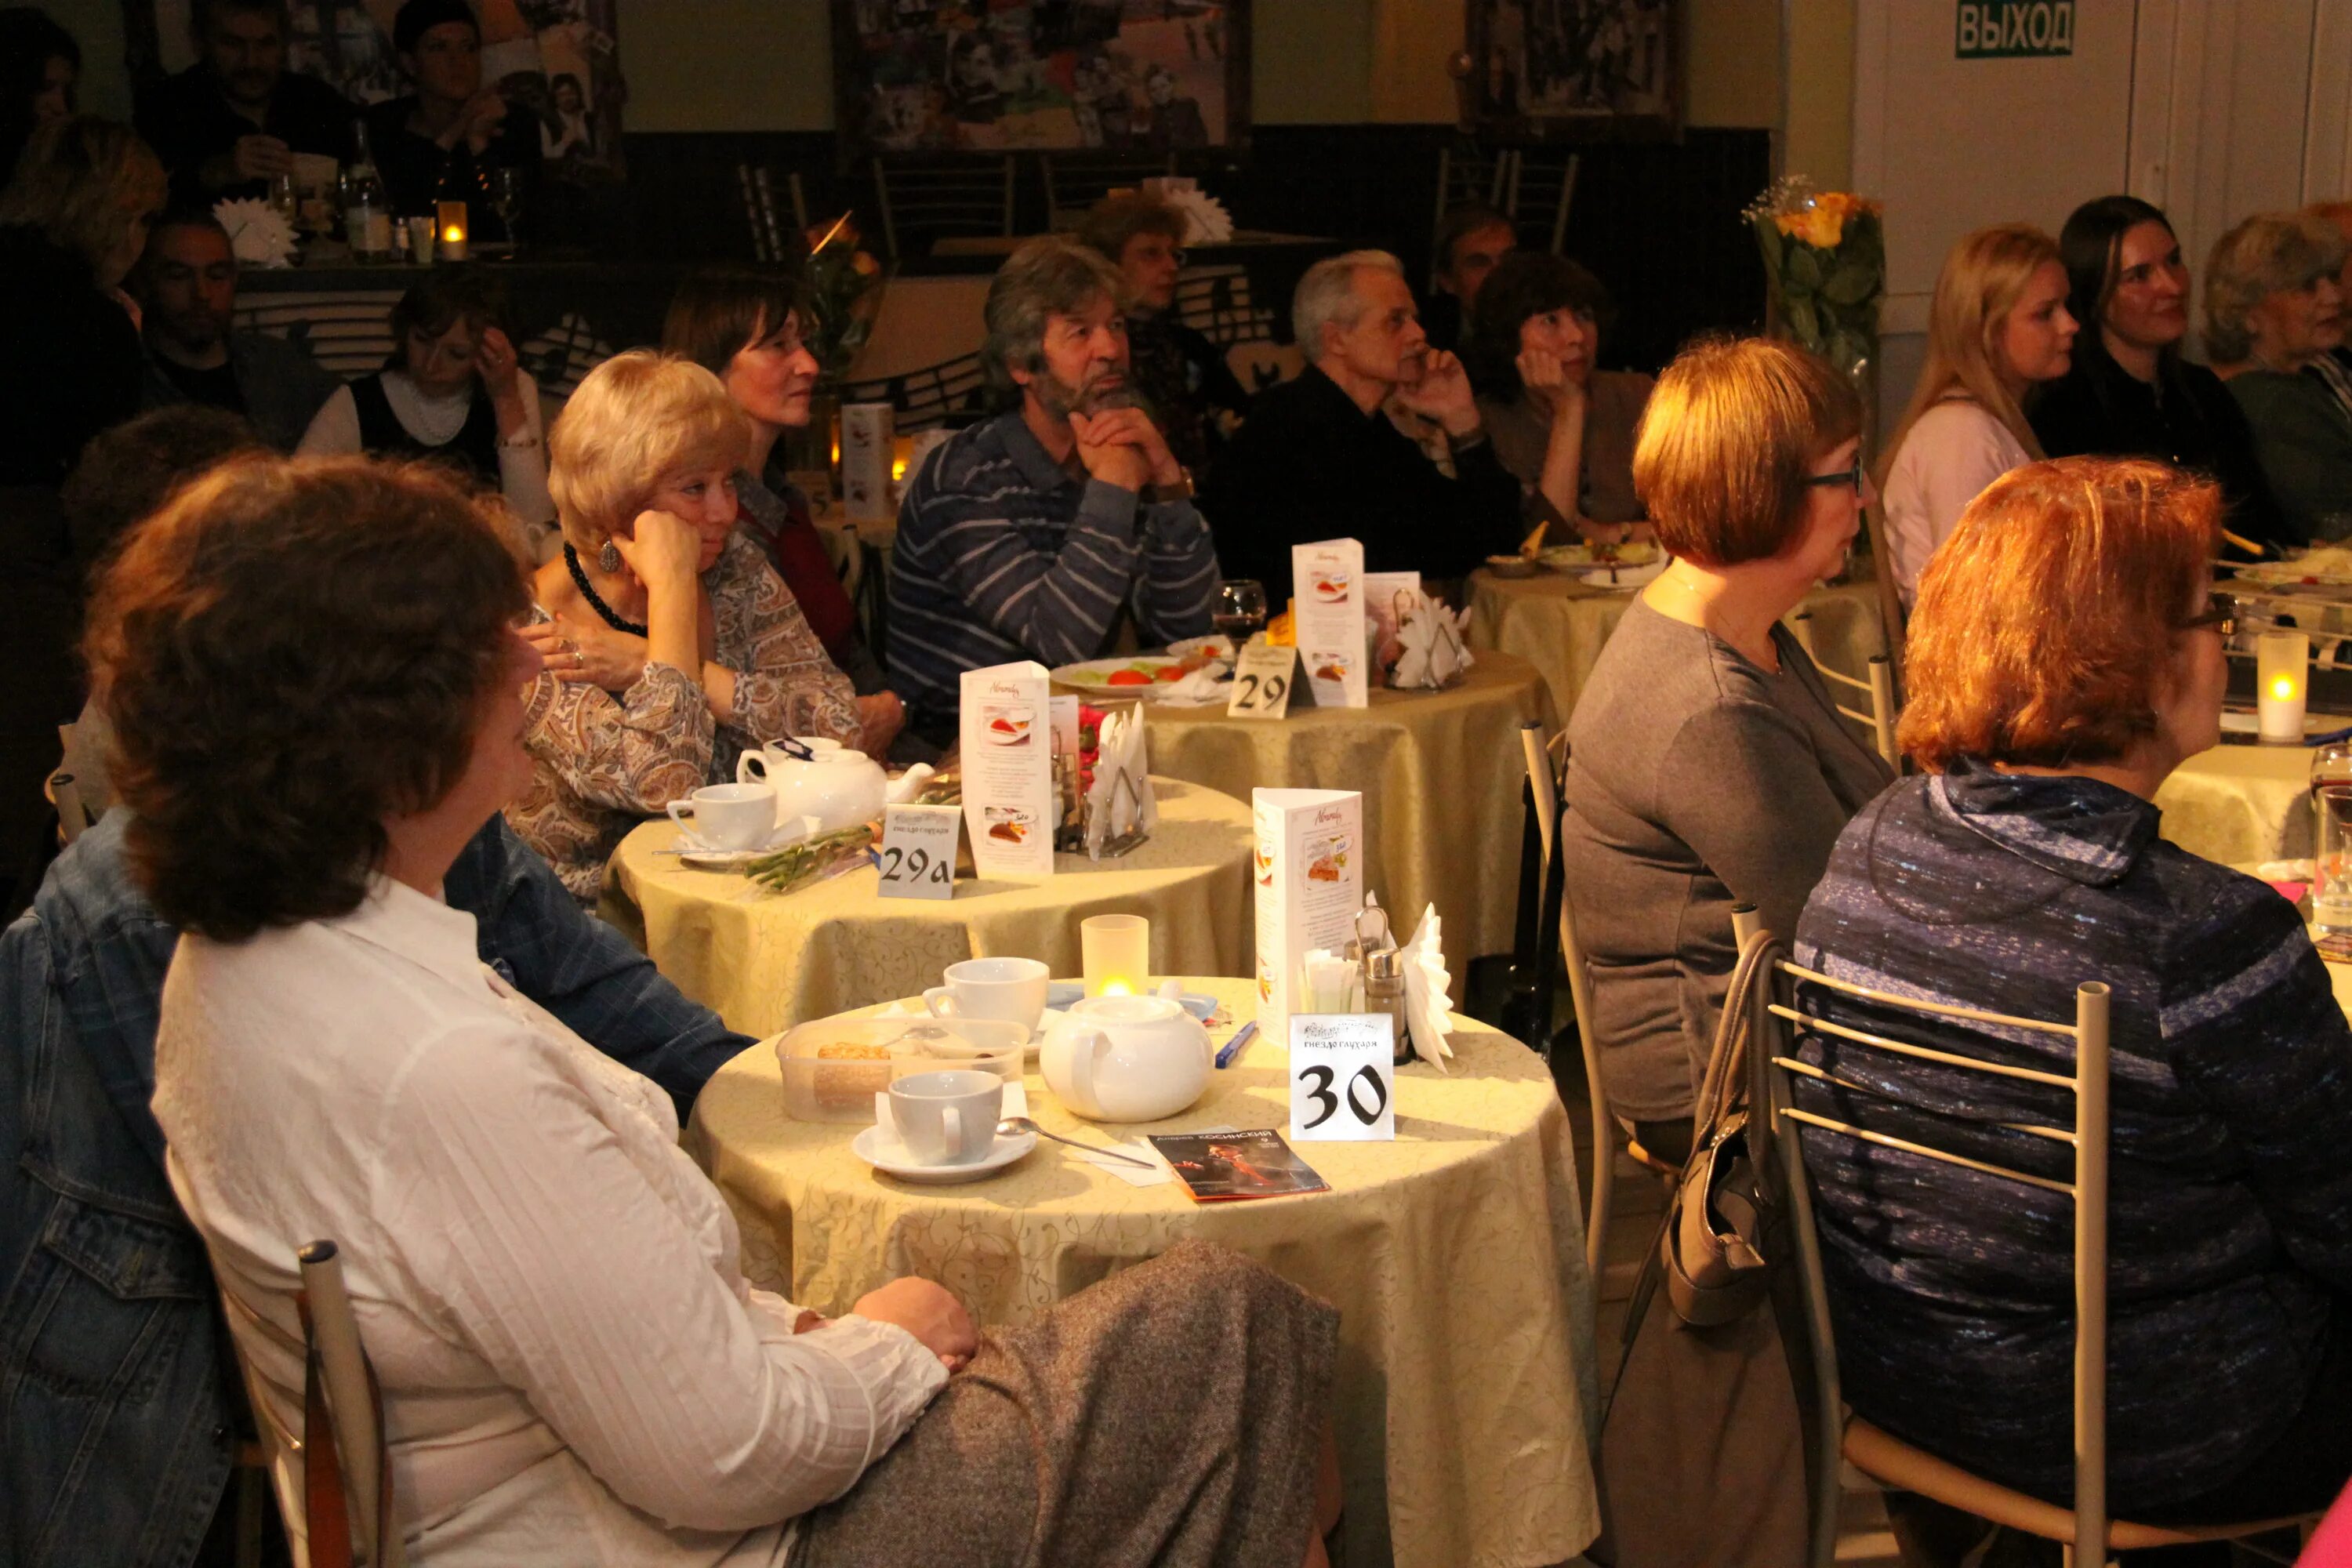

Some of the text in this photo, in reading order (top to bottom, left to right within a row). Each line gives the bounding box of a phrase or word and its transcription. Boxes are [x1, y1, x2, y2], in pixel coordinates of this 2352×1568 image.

[1959, 2, 2071, 49] ВЫХОД
[1235, 673, 1287, 711] 29
[1298, 1064, 1387, 1130] 30
[1198, 1131, 1272, 1140] КОСИНСКИЙ
